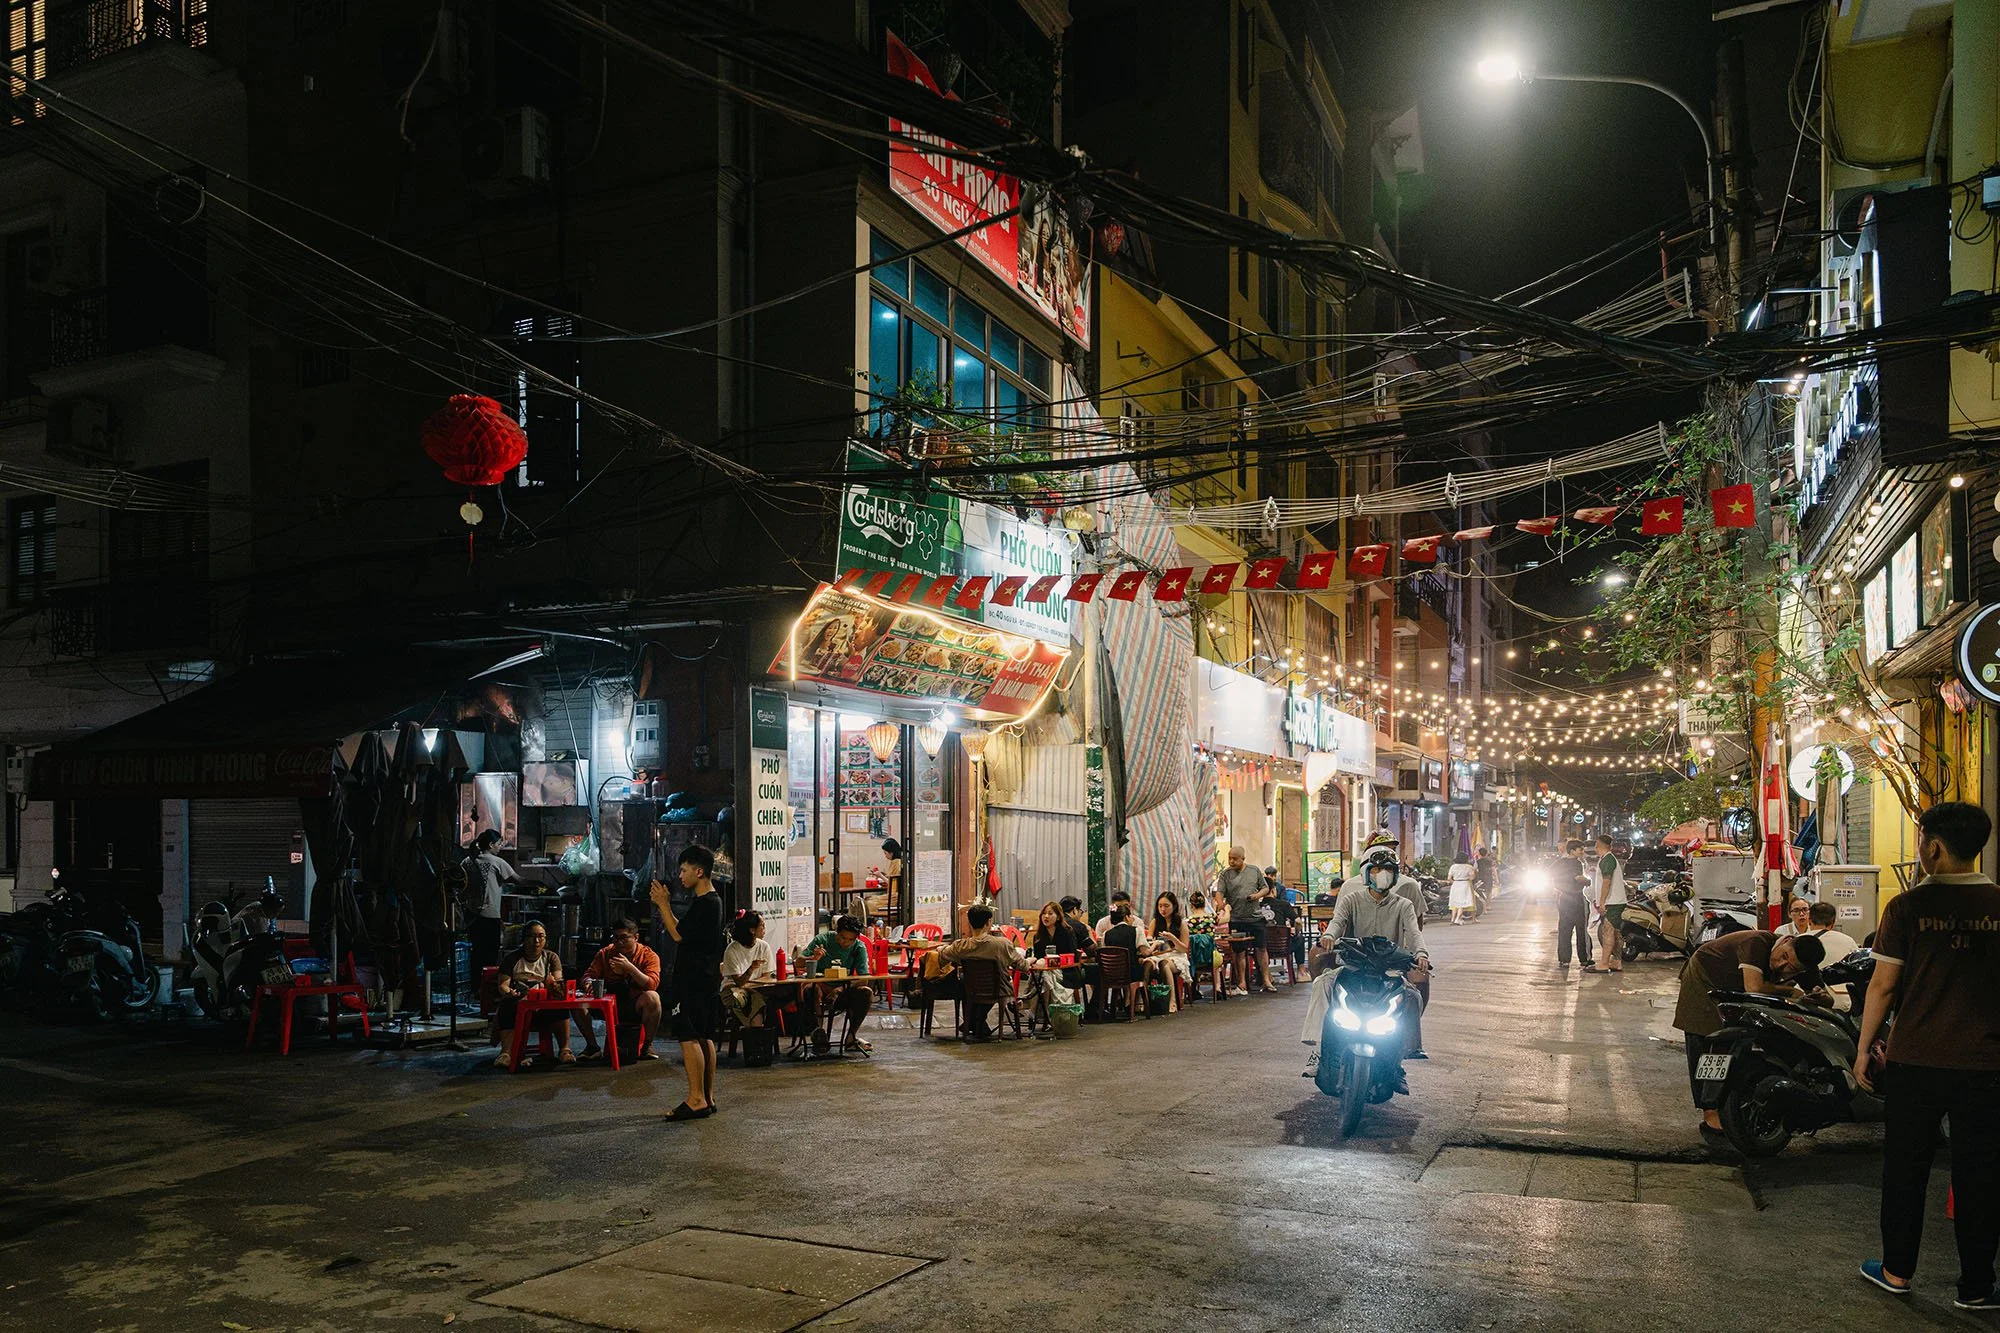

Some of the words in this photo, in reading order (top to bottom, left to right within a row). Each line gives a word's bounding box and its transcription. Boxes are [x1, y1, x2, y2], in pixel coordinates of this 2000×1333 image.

[922, 176, 940, 203] 40
[847, 484, 915, 547] Carlsberg
[843, 543, 867, 556] PROBABLY
[868, 550, 877, 560] THE
[877, 553, 888, 563] BEST
[1000, 530, 1027, 568] PHỞ
[1030, 542, 1062, 576] CUỐN
[761, 754, 780, 774] PHỞ
[758, 779, 782, 799] CUỐN
[757, 807, 783, 825] CHIÊN
[760, 861, 781, 876] VINH
[755, 886, 785, 902] PHONG
[1702, 1055, 1727, 1067] 29-BF
[1697, 1067, 1726, 1078] 032.78
